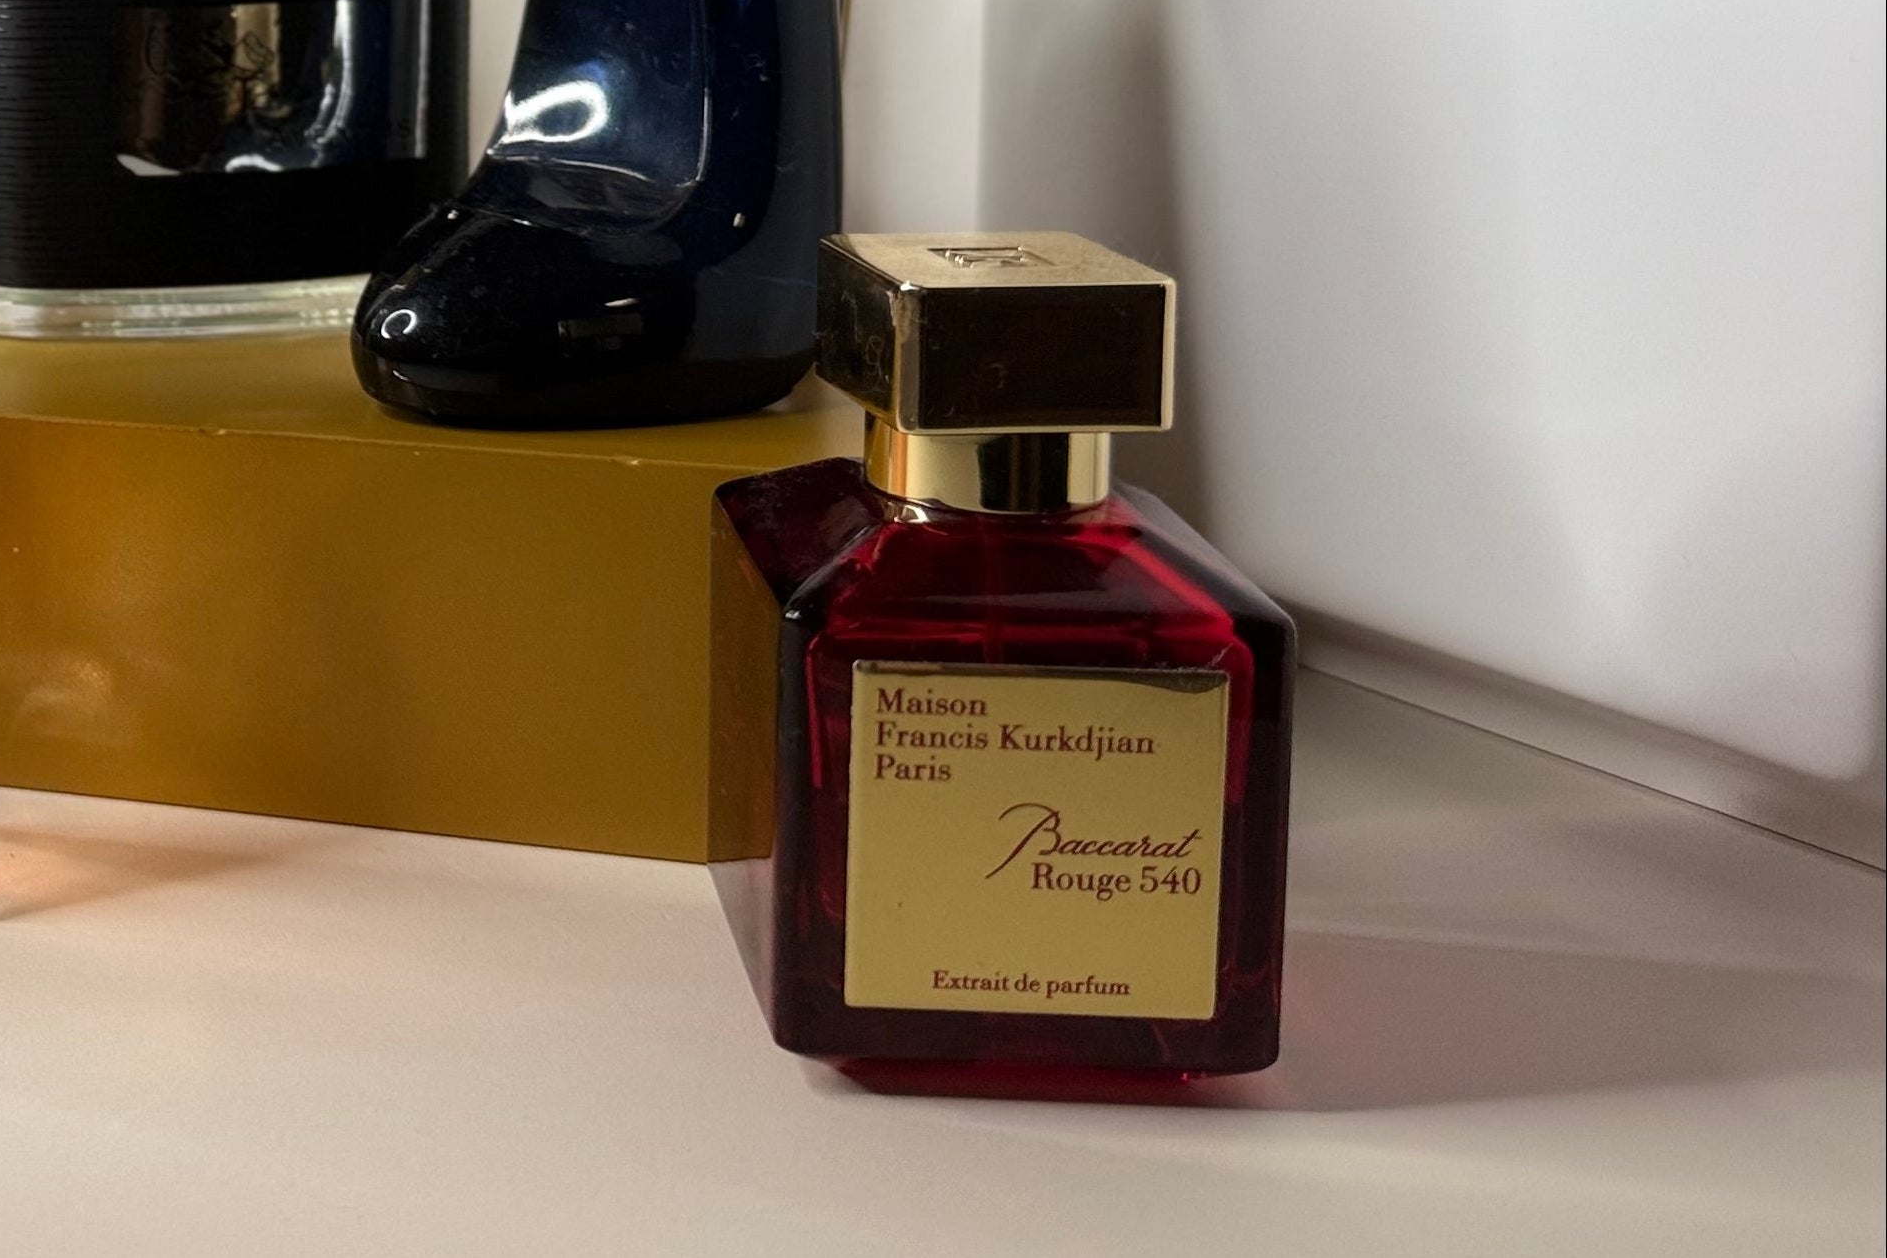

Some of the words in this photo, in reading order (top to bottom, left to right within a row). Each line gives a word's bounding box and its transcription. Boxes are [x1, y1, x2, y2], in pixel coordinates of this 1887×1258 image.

[876, 687, 988, 716] Maison
[875, 720, 989, 750] Francis
[998, 724, 1155, 761] Kurkdjian
[874, 754, 952, 782] Paris
[985, 802, 1202, 880] Baccarat
[1031, 862, 1132, 902] Rouge
[1139, 865, 1202, 896] 540
[932, 970, 1010, 992] Extrait
[1014, 973, 1041, 993] de
[1046, 975, 1131, 999] parfum
